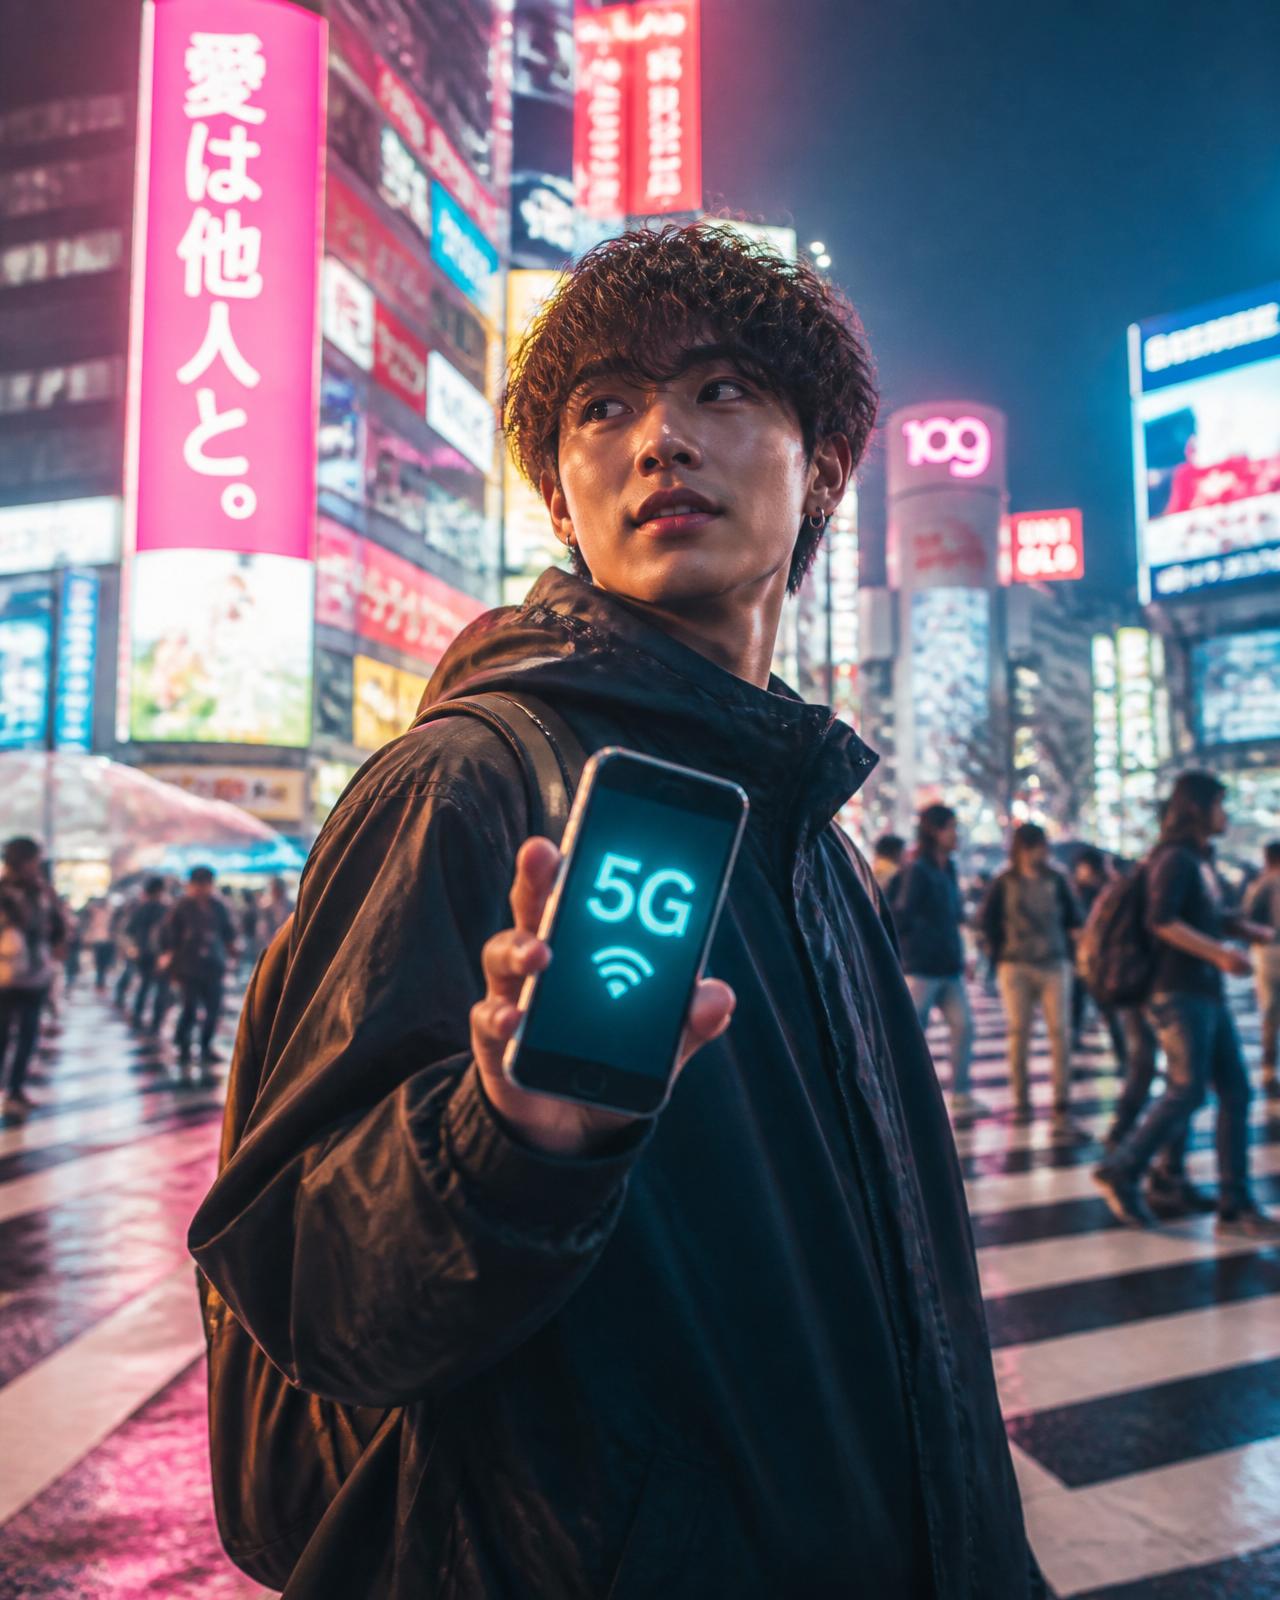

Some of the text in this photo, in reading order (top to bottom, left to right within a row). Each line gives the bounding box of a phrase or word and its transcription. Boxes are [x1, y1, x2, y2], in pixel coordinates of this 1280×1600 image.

[177, 32, 266, 520] 愛は他人と。
[902, 416, 991, 478] 109
[586, 852, 697, 938] 5G
